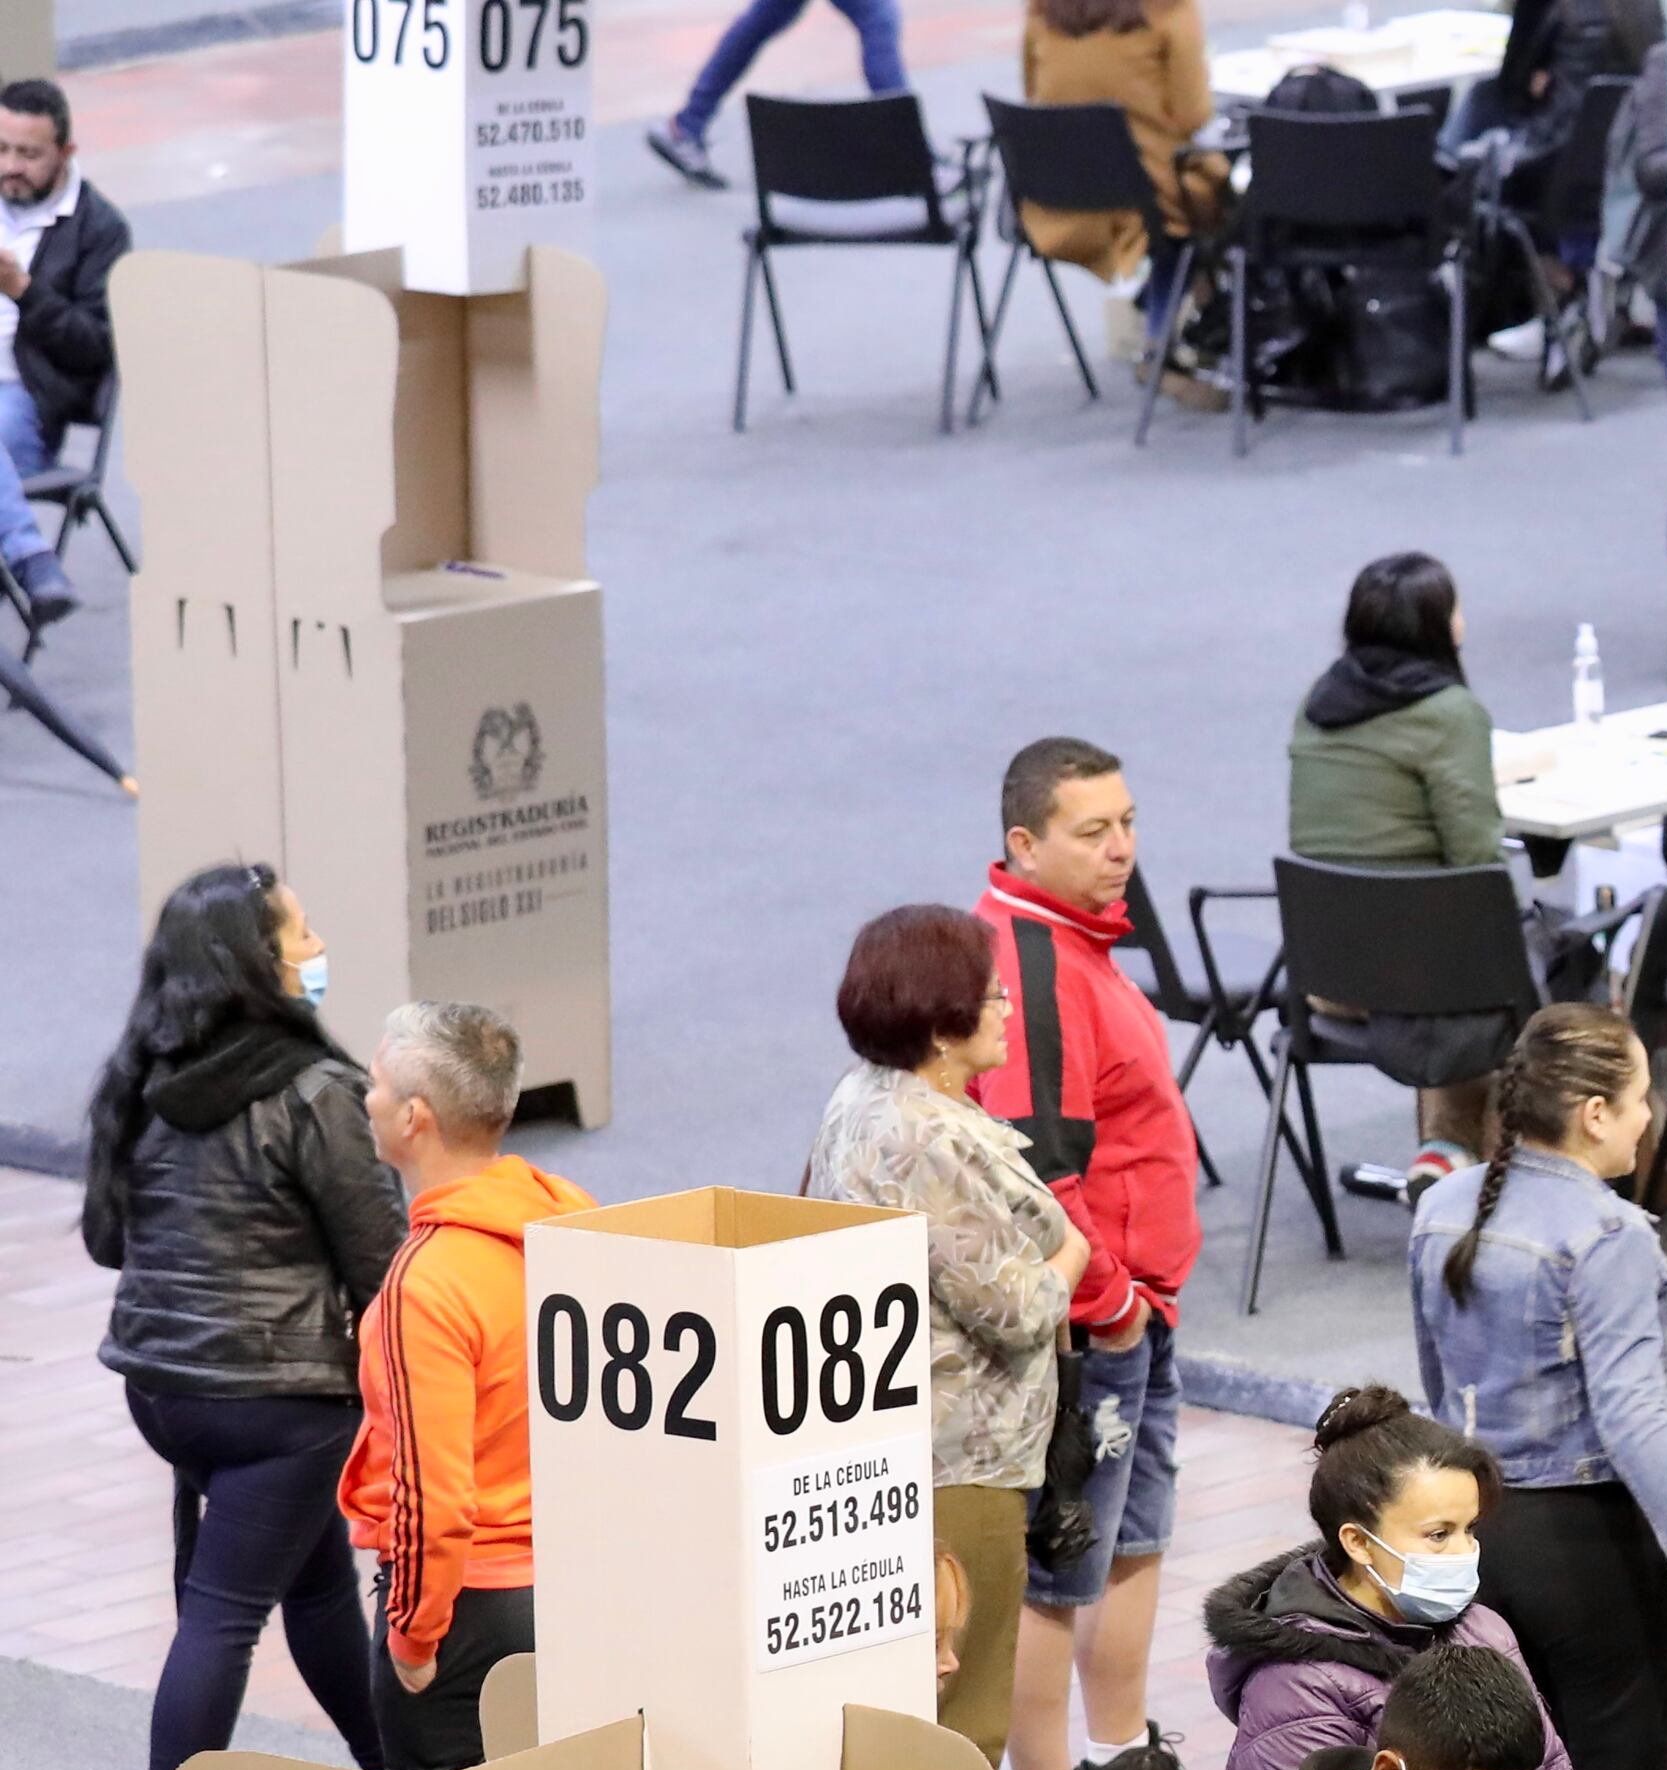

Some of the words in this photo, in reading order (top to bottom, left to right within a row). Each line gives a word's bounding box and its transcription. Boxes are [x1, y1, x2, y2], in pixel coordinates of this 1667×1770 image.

[353, 0, 450, 69] 075
[480, 0, 589, 73] 075
[476, 118, 586, 148] 52.470.510
[475, 179, 585, 210] 52.480.135
[427, 904, 456, 937] DEL
[460, 893, 509, 928] SIGLO
[537, 1293, 717, 1441] 082
[761, 1283, 920, 1435] 082
[793, 1475, 811, 1497] DE
[815, 1470, 832, 1491] LA
[836, 1457, 889, 1487] CÉDULA
[764, 1481, 920, 1552] 52.513.498
[783, 1574, 826, 1601] HASTA
[830, 1568, 848, 1590] LA
[851, 1555, 904, 1585] CÉDULA
[766, 1582, 922, 1655] 52.522.184
